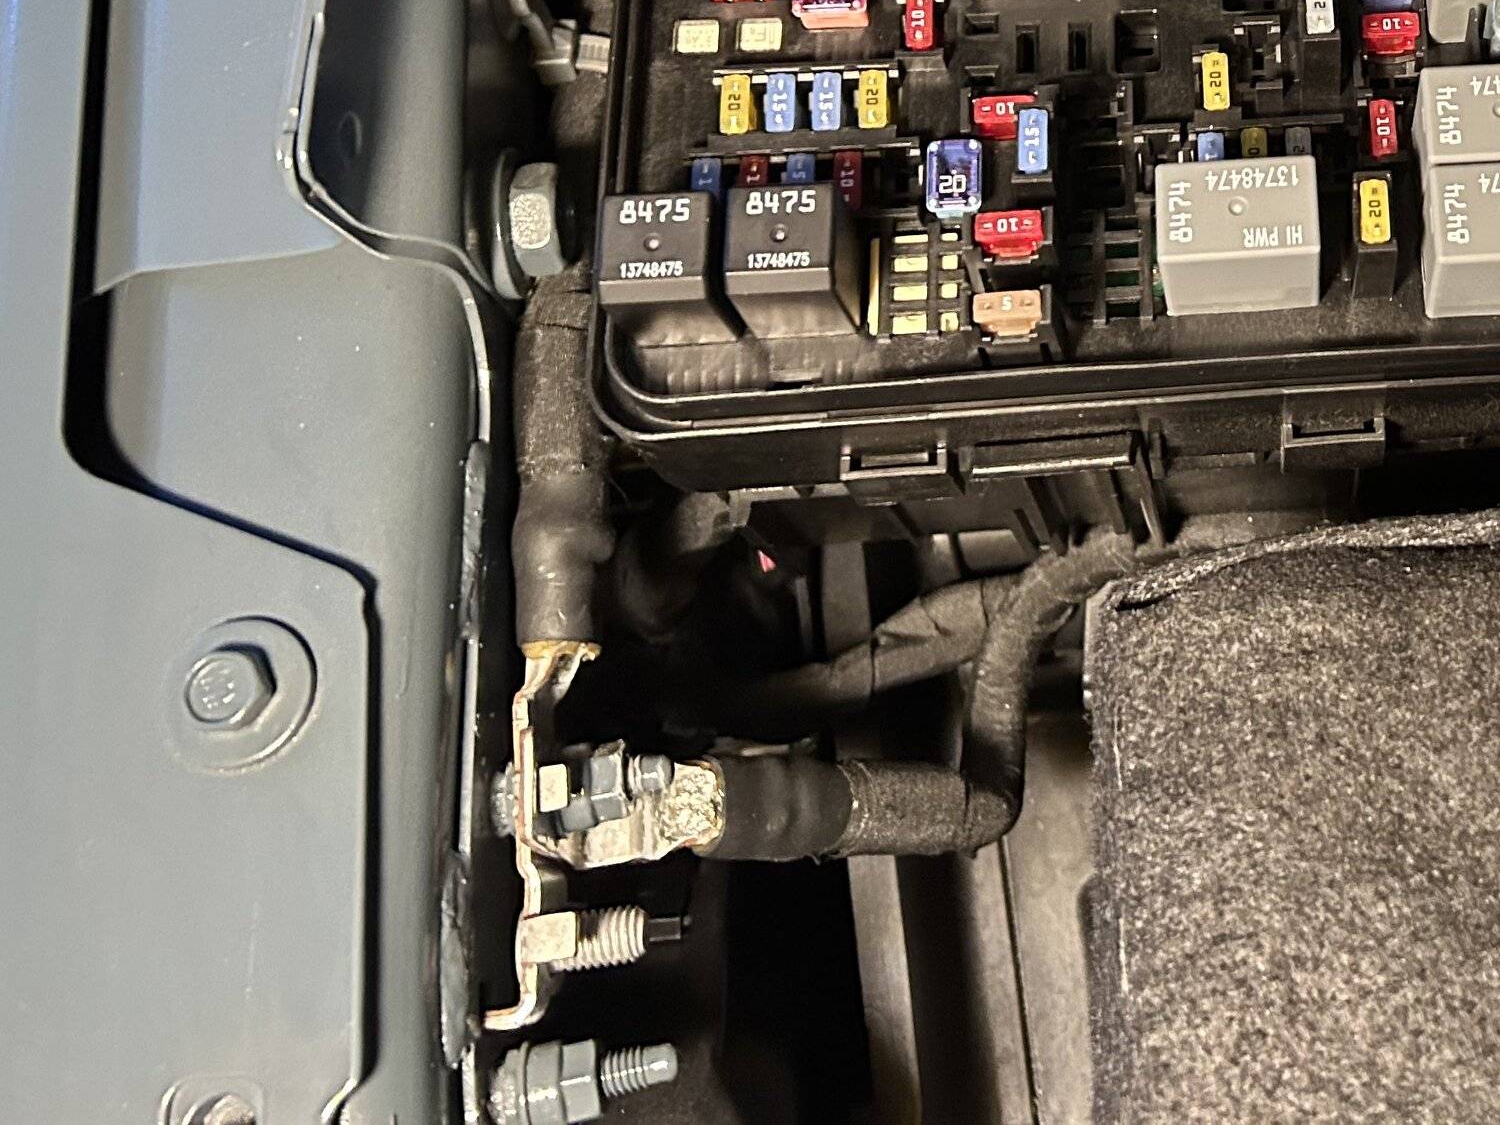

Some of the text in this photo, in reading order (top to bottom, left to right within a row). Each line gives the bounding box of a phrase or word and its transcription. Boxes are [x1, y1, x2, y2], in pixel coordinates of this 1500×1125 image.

[911, 10, 925, 26] 10
[1382, 18, 1400, 30] 10
[1210, 71, 1222, 88] 20
[728, 94, 740, 111] 20
[772, 92, 787, 113] 15
[819, 92, 834, 112] 15
[866, 88, 878, 105] 20
[996, 102, 1015, 114] 10
[1436, 86, 1462, 144] 8474
[1024, 127, 1040, 147] 15
[1376, 118, 1390, 136] 10
[938, 174, 966, 194] 20
[1204, 164, 1300, 192] 13748474
[619, 198, 690, 224] 8475
[745, 189, 816, 216] 8475
[1168, 181, 1192, 244] 8474
[1368, 200, 1382, 218] 20
[1444, 184, 1470, 244] 8474
[996, 219, 1018, 232] 10
[1244, 224, 1304, 248] HI PWR
[620, 260, 684, 280] 13748475
[748, 251, 810, 270] 13748475
